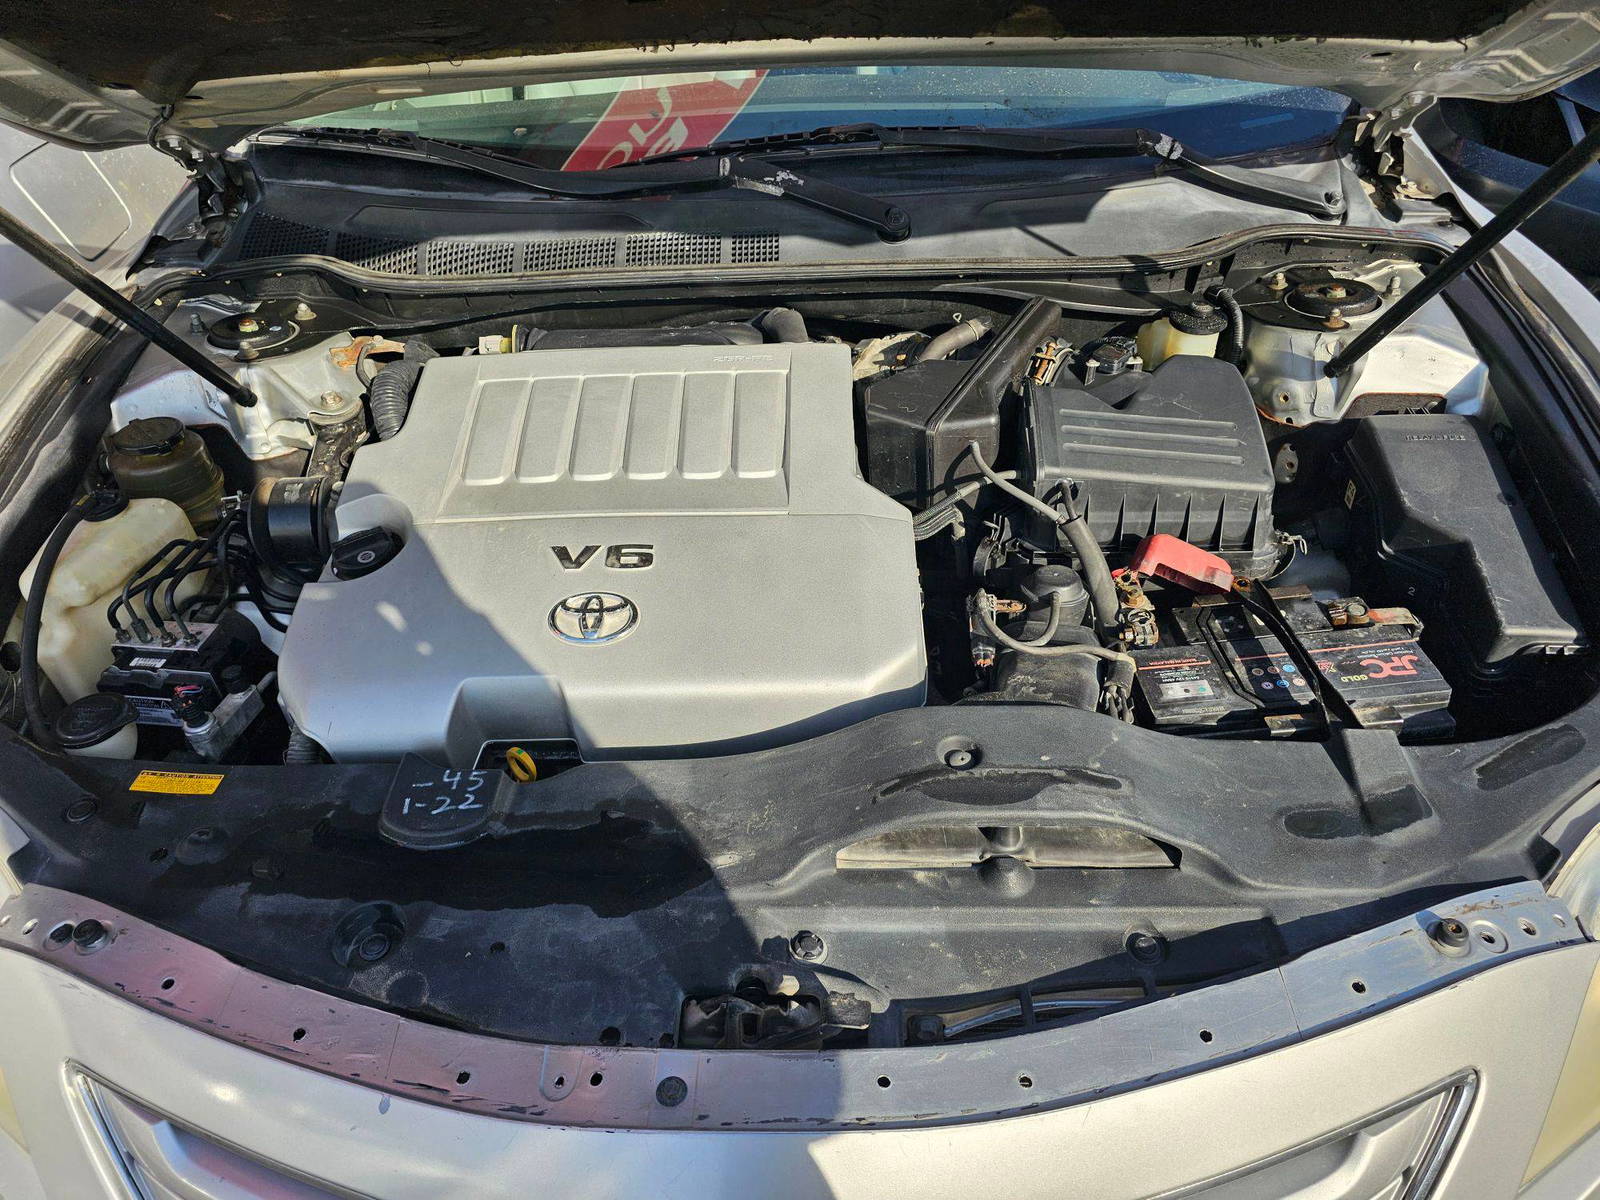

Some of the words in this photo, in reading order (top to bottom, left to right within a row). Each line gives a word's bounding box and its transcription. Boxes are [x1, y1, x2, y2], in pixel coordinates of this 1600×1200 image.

[550, 544, 654, 570] V6
[1340, 674, 1369, 682] GOLD
[1360, 655, 1419, 679] JPC
[402, 794, 484, 815] 1-22
